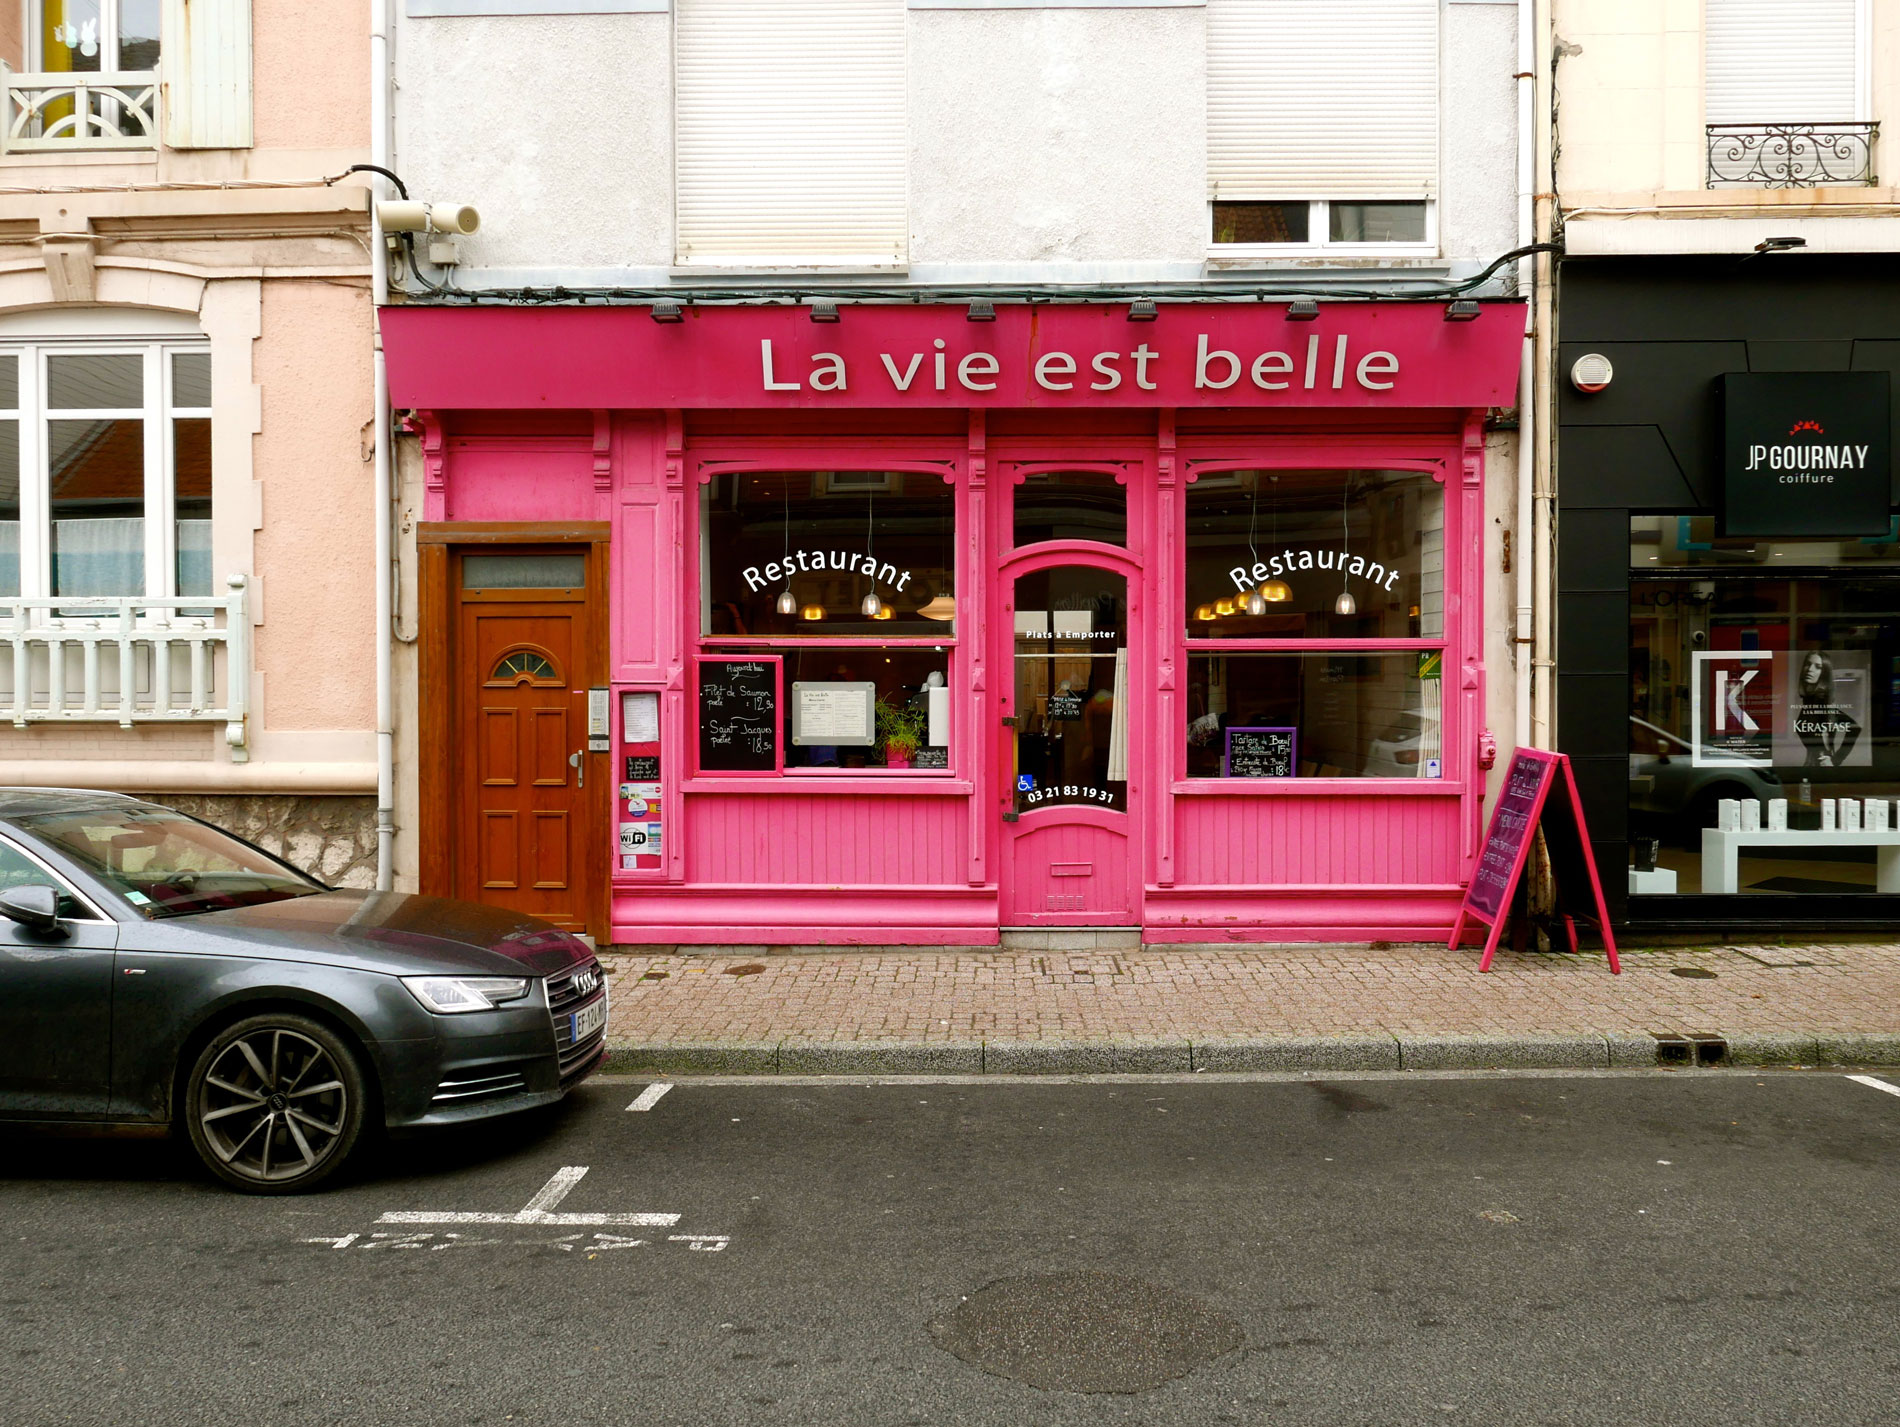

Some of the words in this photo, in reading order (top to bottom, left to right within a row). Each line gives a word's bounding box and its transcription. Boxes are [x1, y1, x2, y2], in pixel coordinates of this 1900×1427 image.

[761, 338, 848, 392] La
[880, 337, 1000, 392] vie
[1034, 342, 1160, 392] est
[1195, 333, 1400, 392] belle
[1745, 445, 1767, 470] JP
[1770, 445, 1869, 470] GOURNAY
[1779, 473, 1834, 484] coiffure
[742, 549, 912, 593] Restaurant
[1229, 549, 1400, 593] Restaurant
[1026, 630, 1052, 639] Plats
[1056, 630, 1062, 639] à
[1066, 631, 1115, 641] Emporter
[703, 685, 726, 697] Filet
[740, 685, 772, 697] Saumon
[1715, 670, 1760, 731] K
[710, 720, 738, 734] Saint
[740, 724, 772, 739] Jacques
[1793, 719, 1852, 733] KÉRASTASE
[1028, 790, 1043, 803] 03
[1045, 786, 1059, 798] 21
[1063, 785, 1078, 796] 83
[1082, 787, 1097, 798] 19
[1099, 790, 1114, 803] 31
